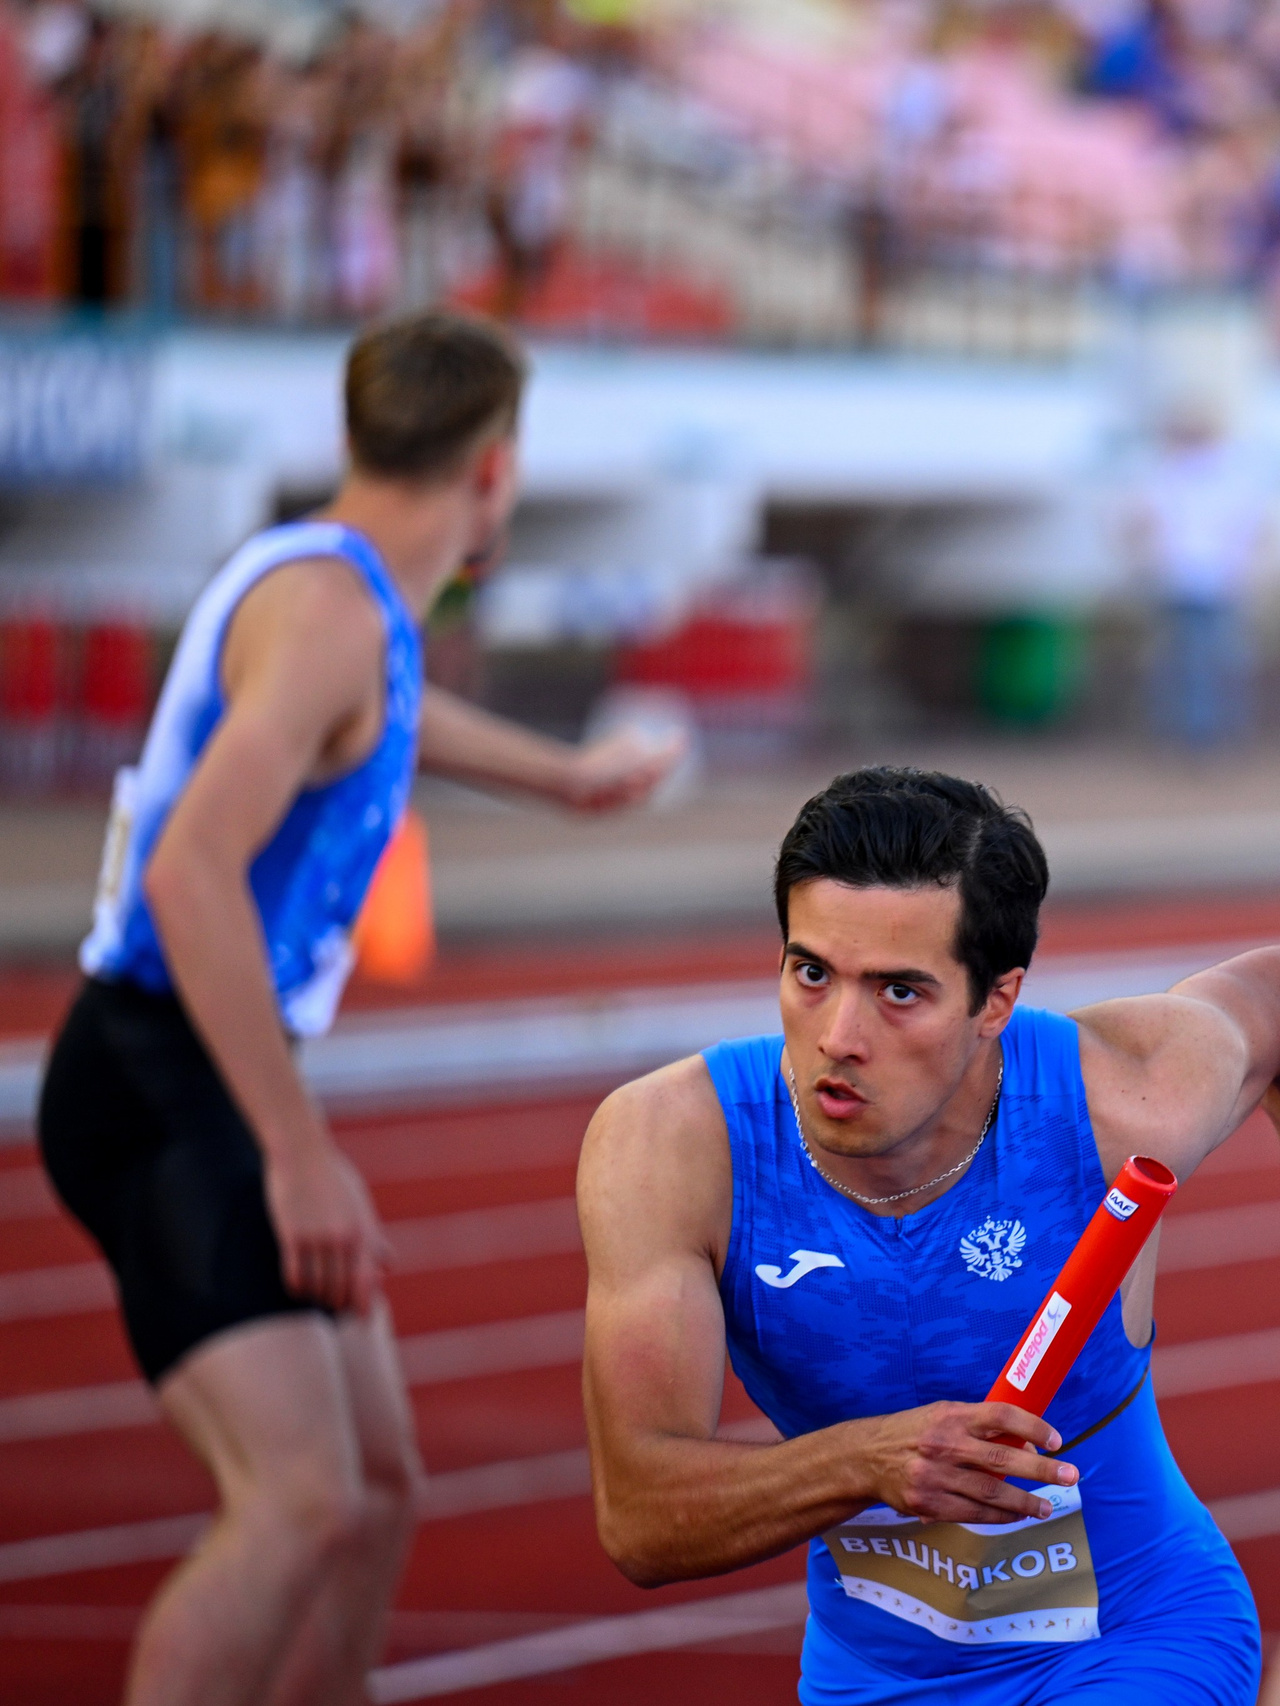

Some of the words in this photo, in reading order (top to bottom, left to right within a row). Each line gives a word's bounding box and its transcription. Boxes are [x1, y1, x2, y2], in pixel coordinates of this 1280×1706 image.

[1109, 1192, 1134, 1212] IAAF
[1013, 1318, 1048, 1382] polanik
[839, 1537, 1078, 1591] ВЕШНЯКОВ
